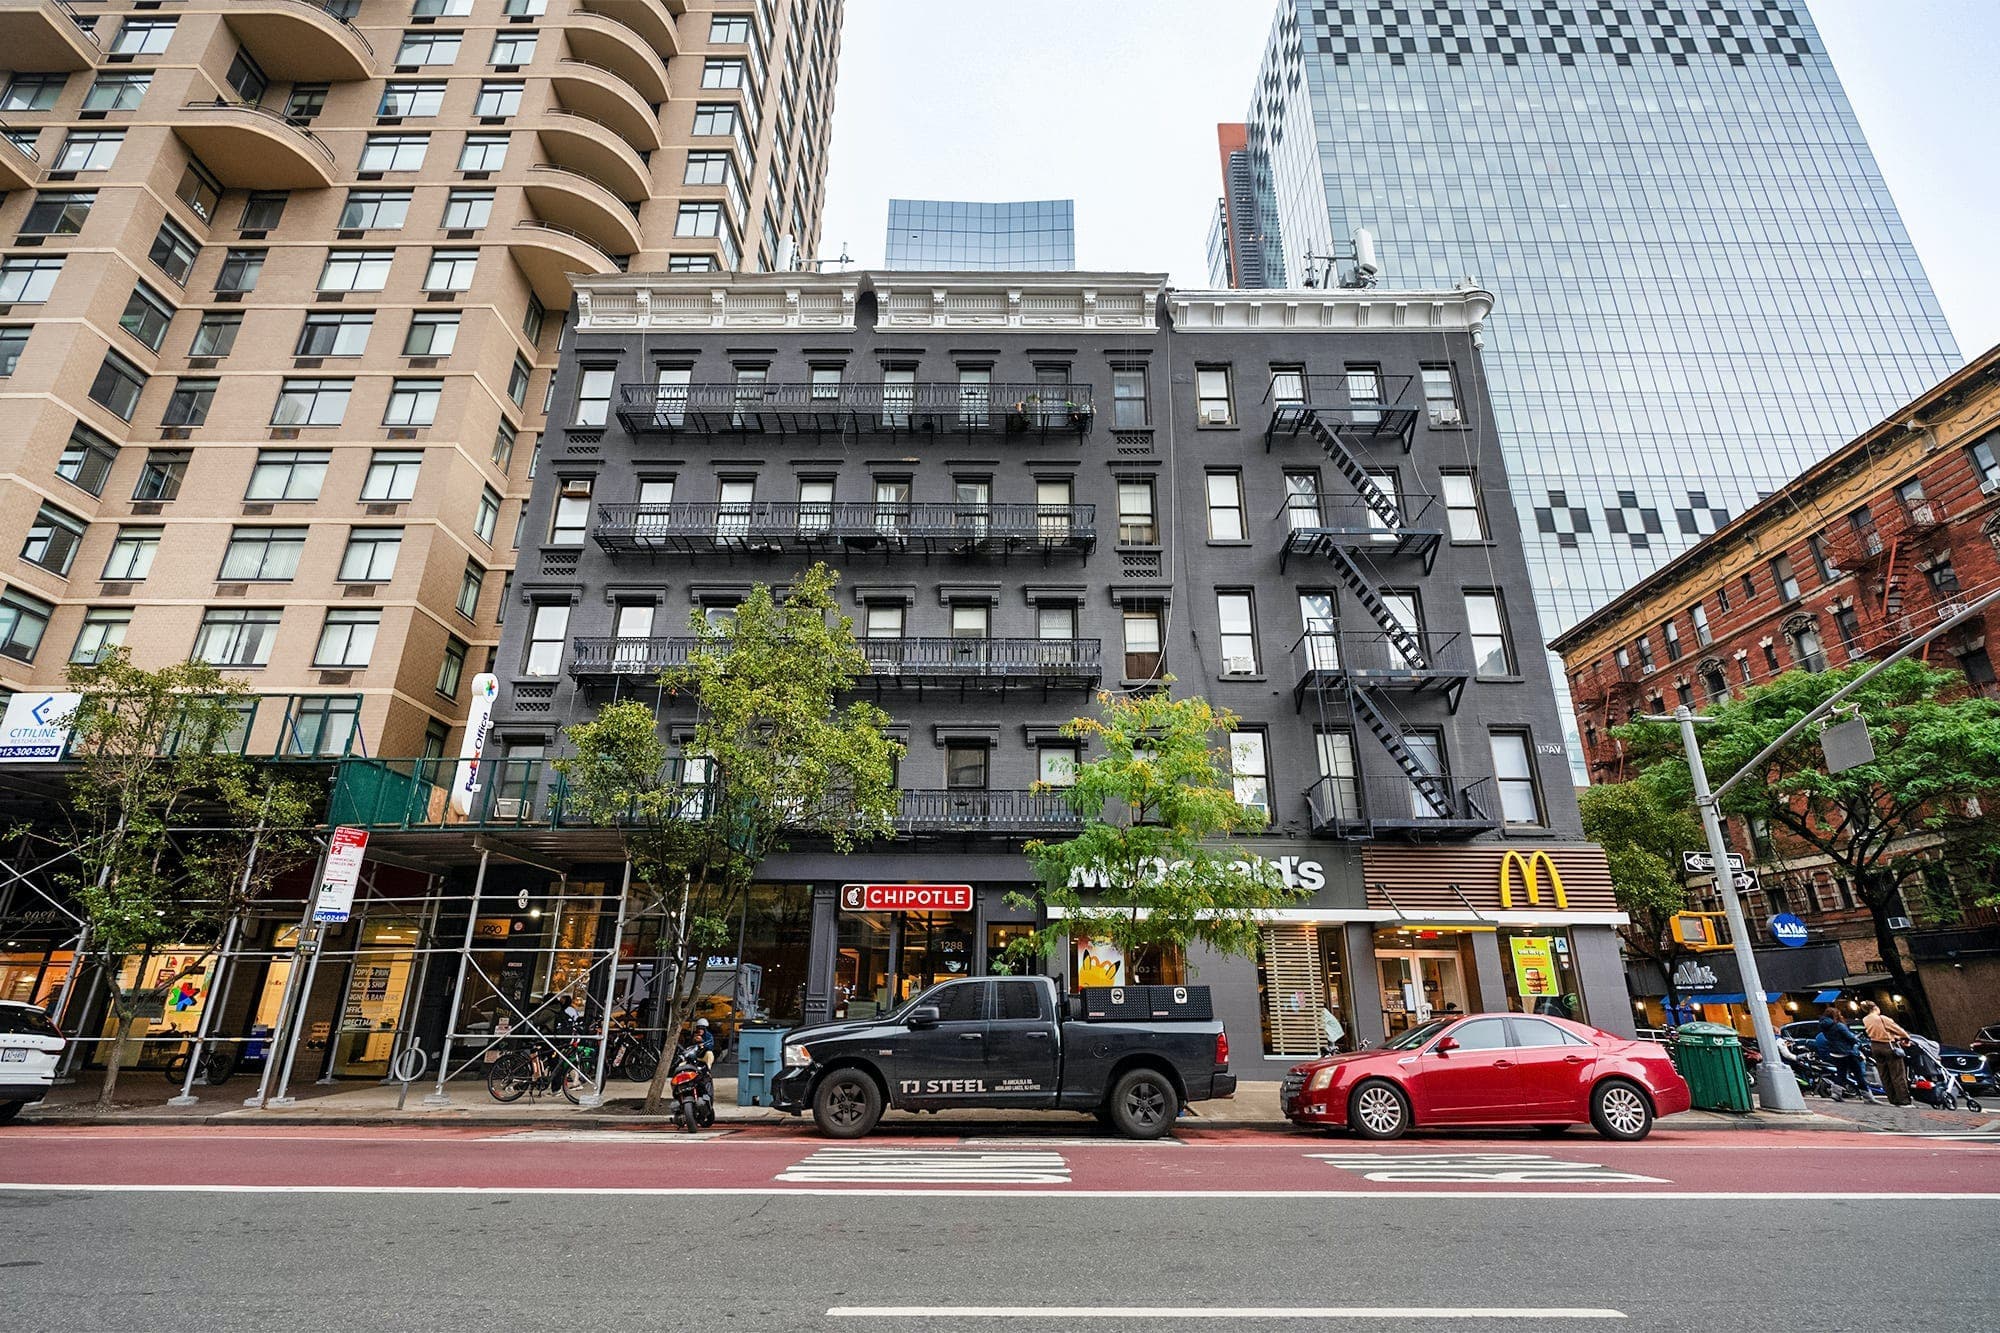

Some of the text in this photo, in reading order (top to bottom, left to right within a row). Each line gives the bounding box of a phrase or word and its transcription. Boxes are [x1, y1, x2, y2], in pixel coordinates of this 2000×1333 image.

[10, 728, 57, 738] CITILINE
[465, 712, 489, 793] FedEx Office
[1693, 858, 1711, 866] ONE
[1067, 855, 1326, 890] McDoald's
[870, 890, 966, 905] CHIPOTLE
[940, 941, 963, 950] 1288
[1558, 939, 1566, 948] A
[900, 1079, 987, 1094] TJ STEEL
